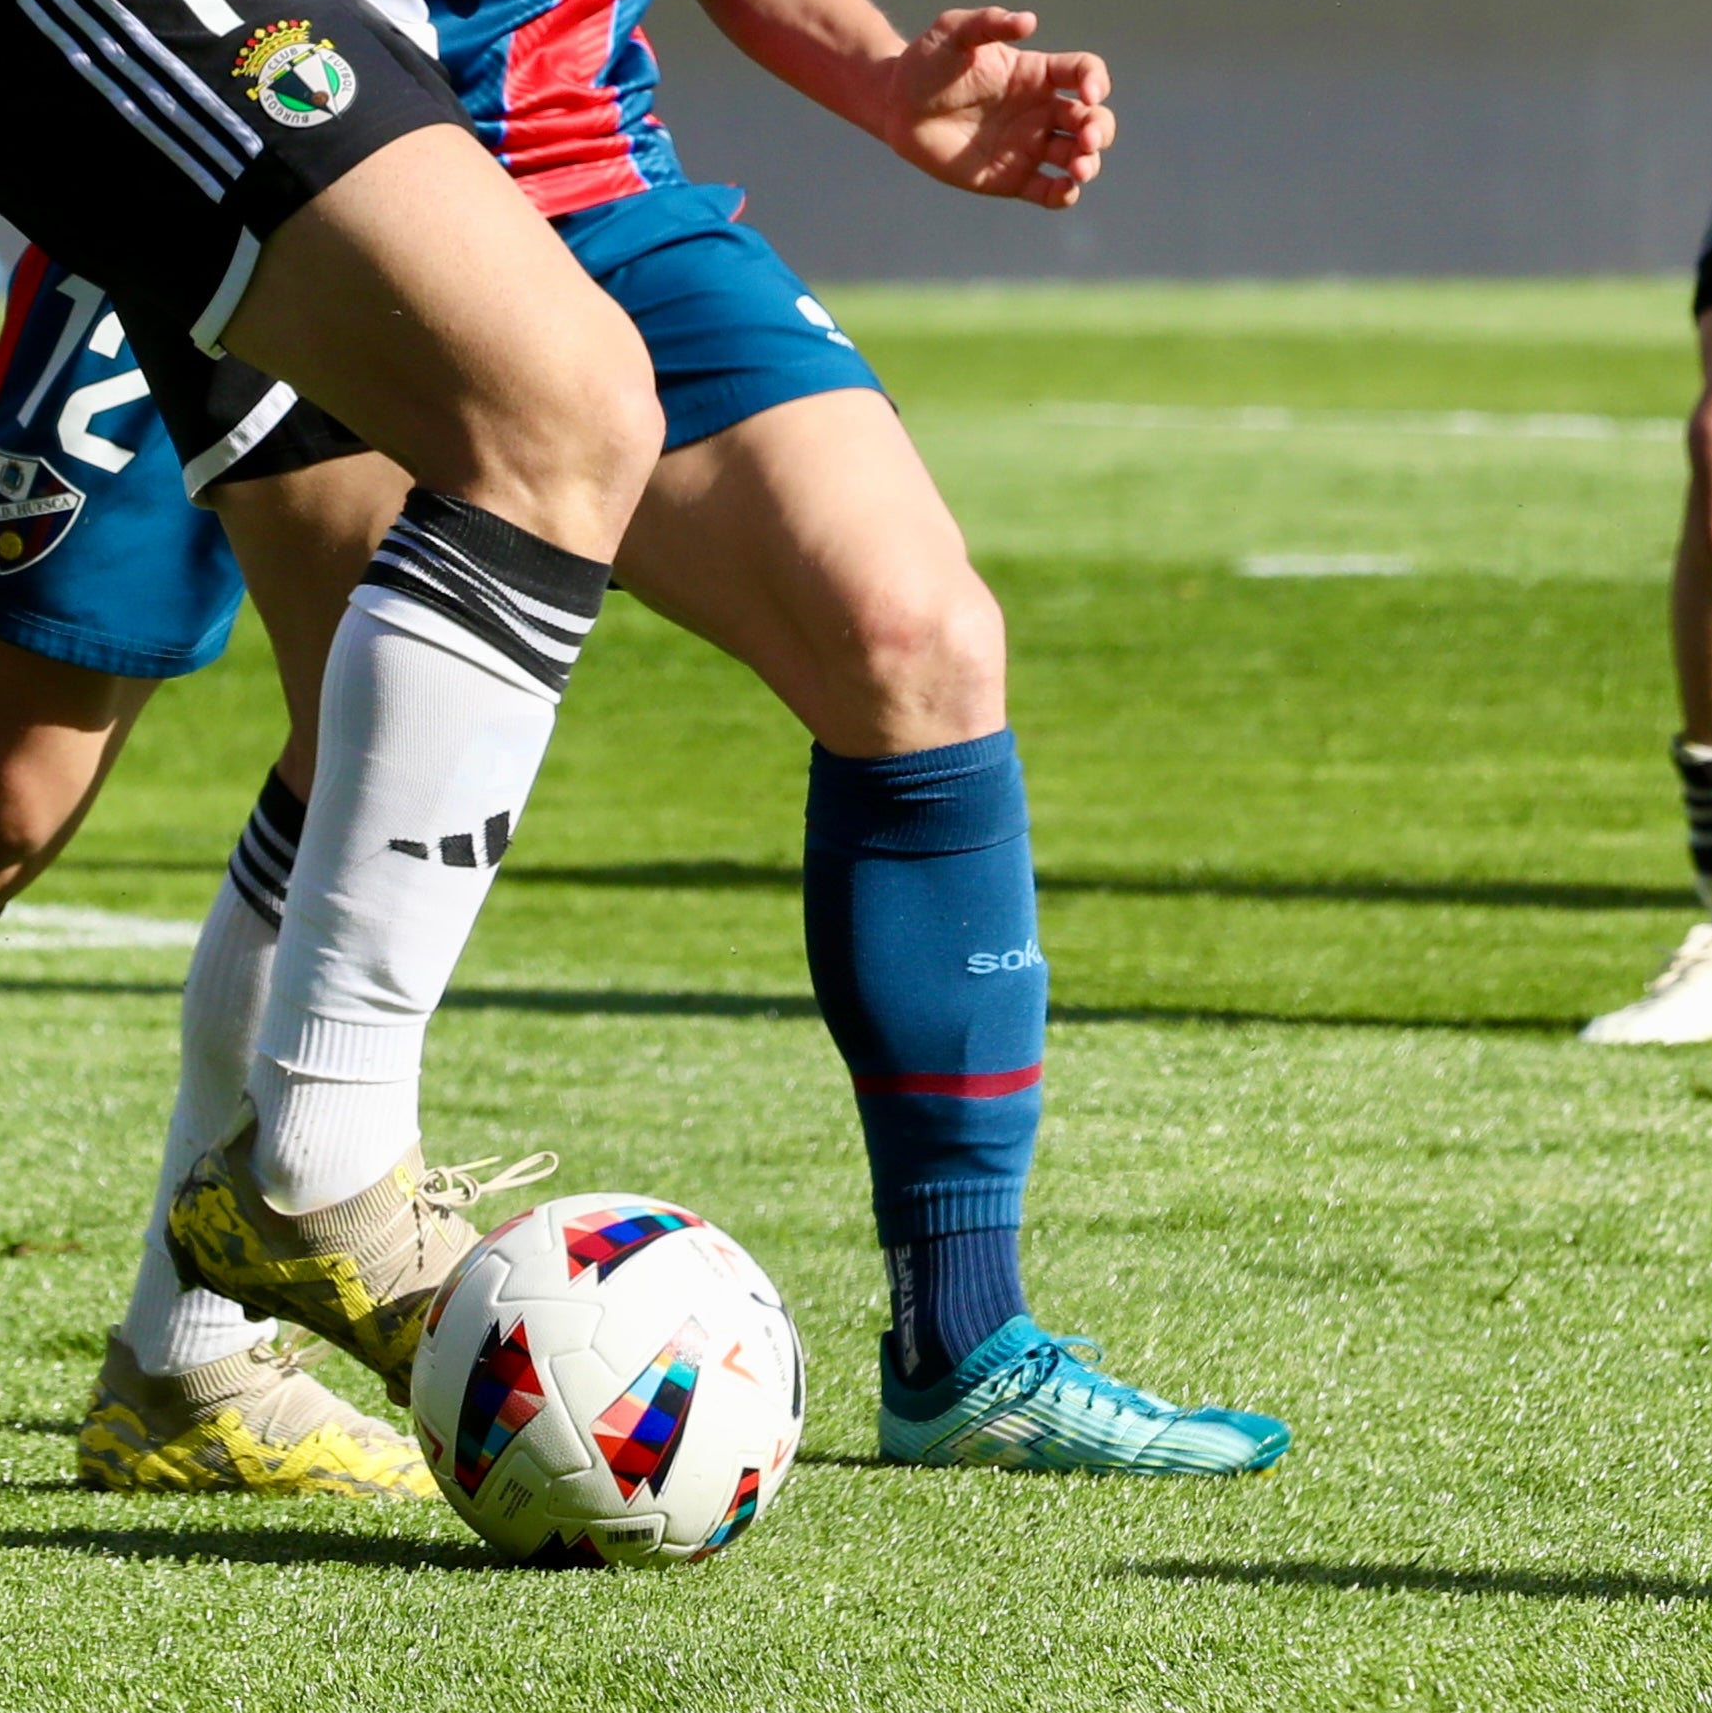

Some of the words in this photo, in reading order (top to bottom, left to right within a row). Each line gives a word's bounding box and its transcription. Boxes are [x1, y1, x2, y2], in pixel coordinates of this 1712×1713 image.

[267, 47, 299, 71] CLUB
[326, 54, 353, 92] FUTBOL
[263, 93, 310, 124] BURGOS
[17, 273, 151, 474] 12
[966, 938, 1045, 975] sok
